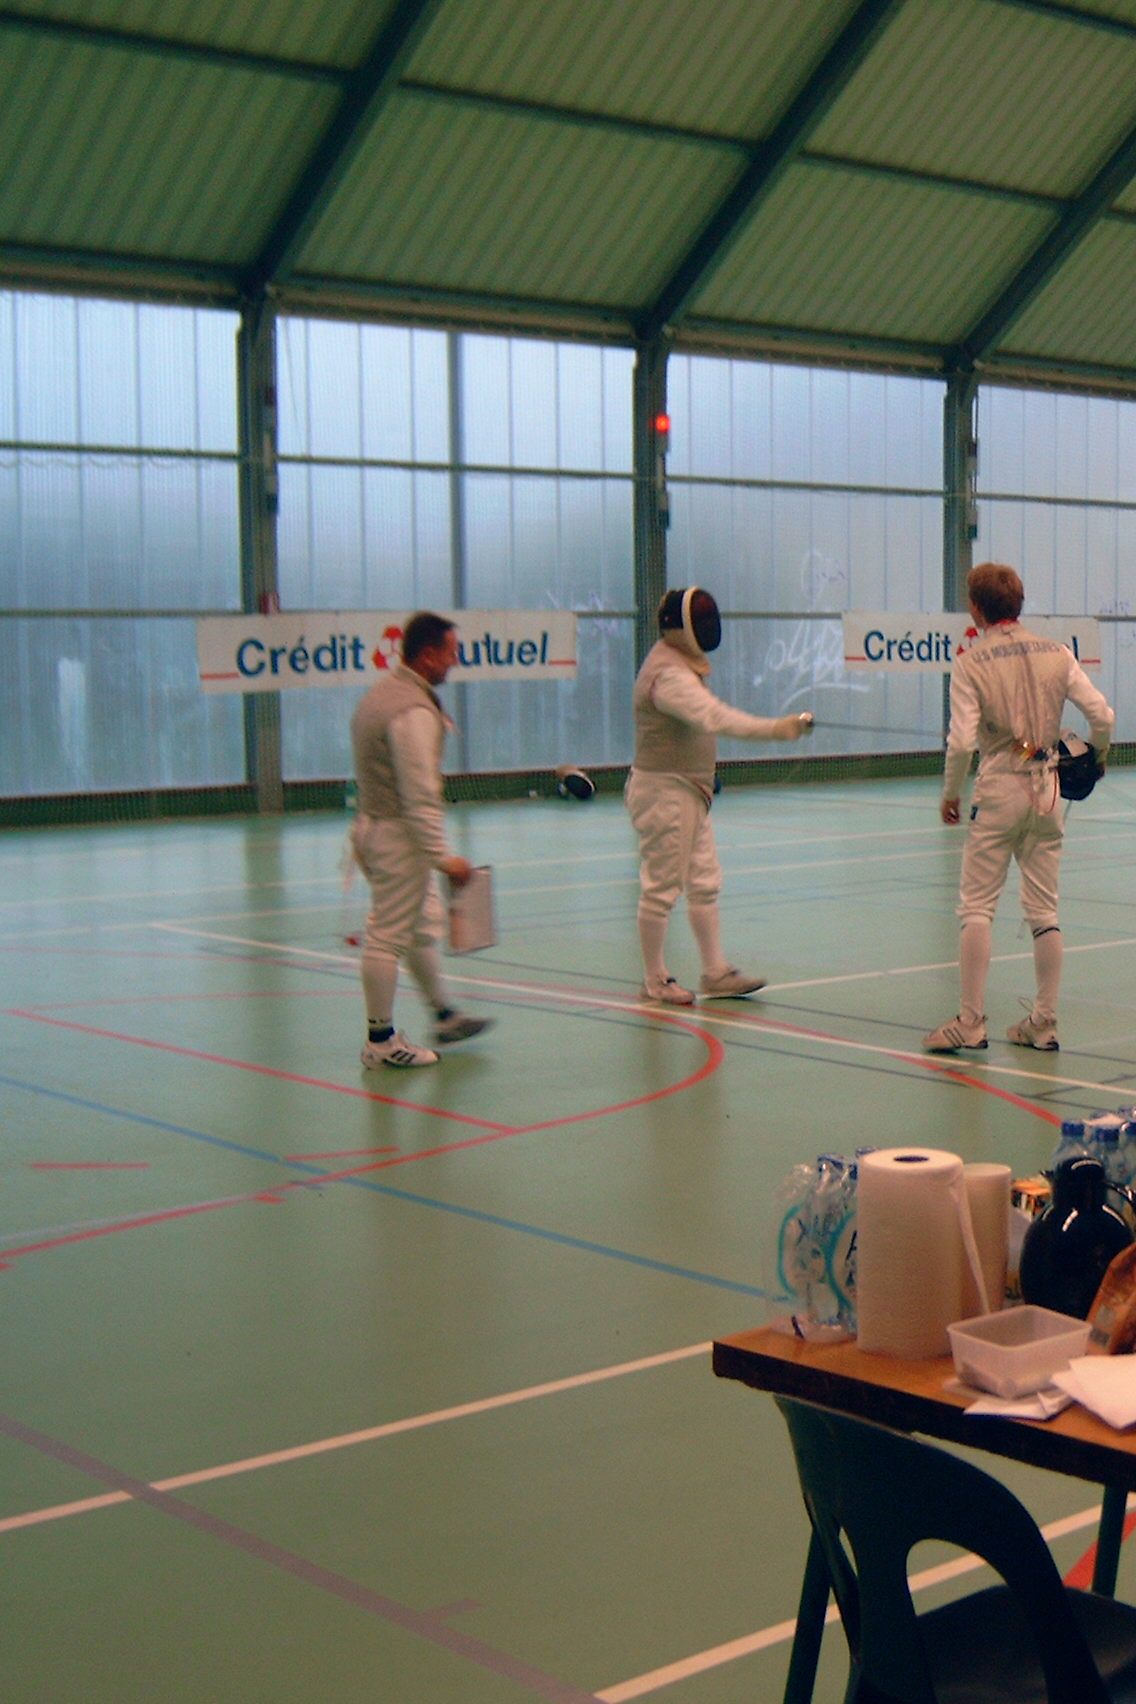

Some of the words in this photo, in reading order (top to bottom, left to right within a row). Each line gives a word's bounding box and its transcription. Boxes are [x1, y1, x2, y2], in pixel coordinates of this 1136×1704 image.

[237, 633, 365, 677] Crédit
[454, 631, 548, 668] utuel
[864, 630, 952, 663] Crédit
